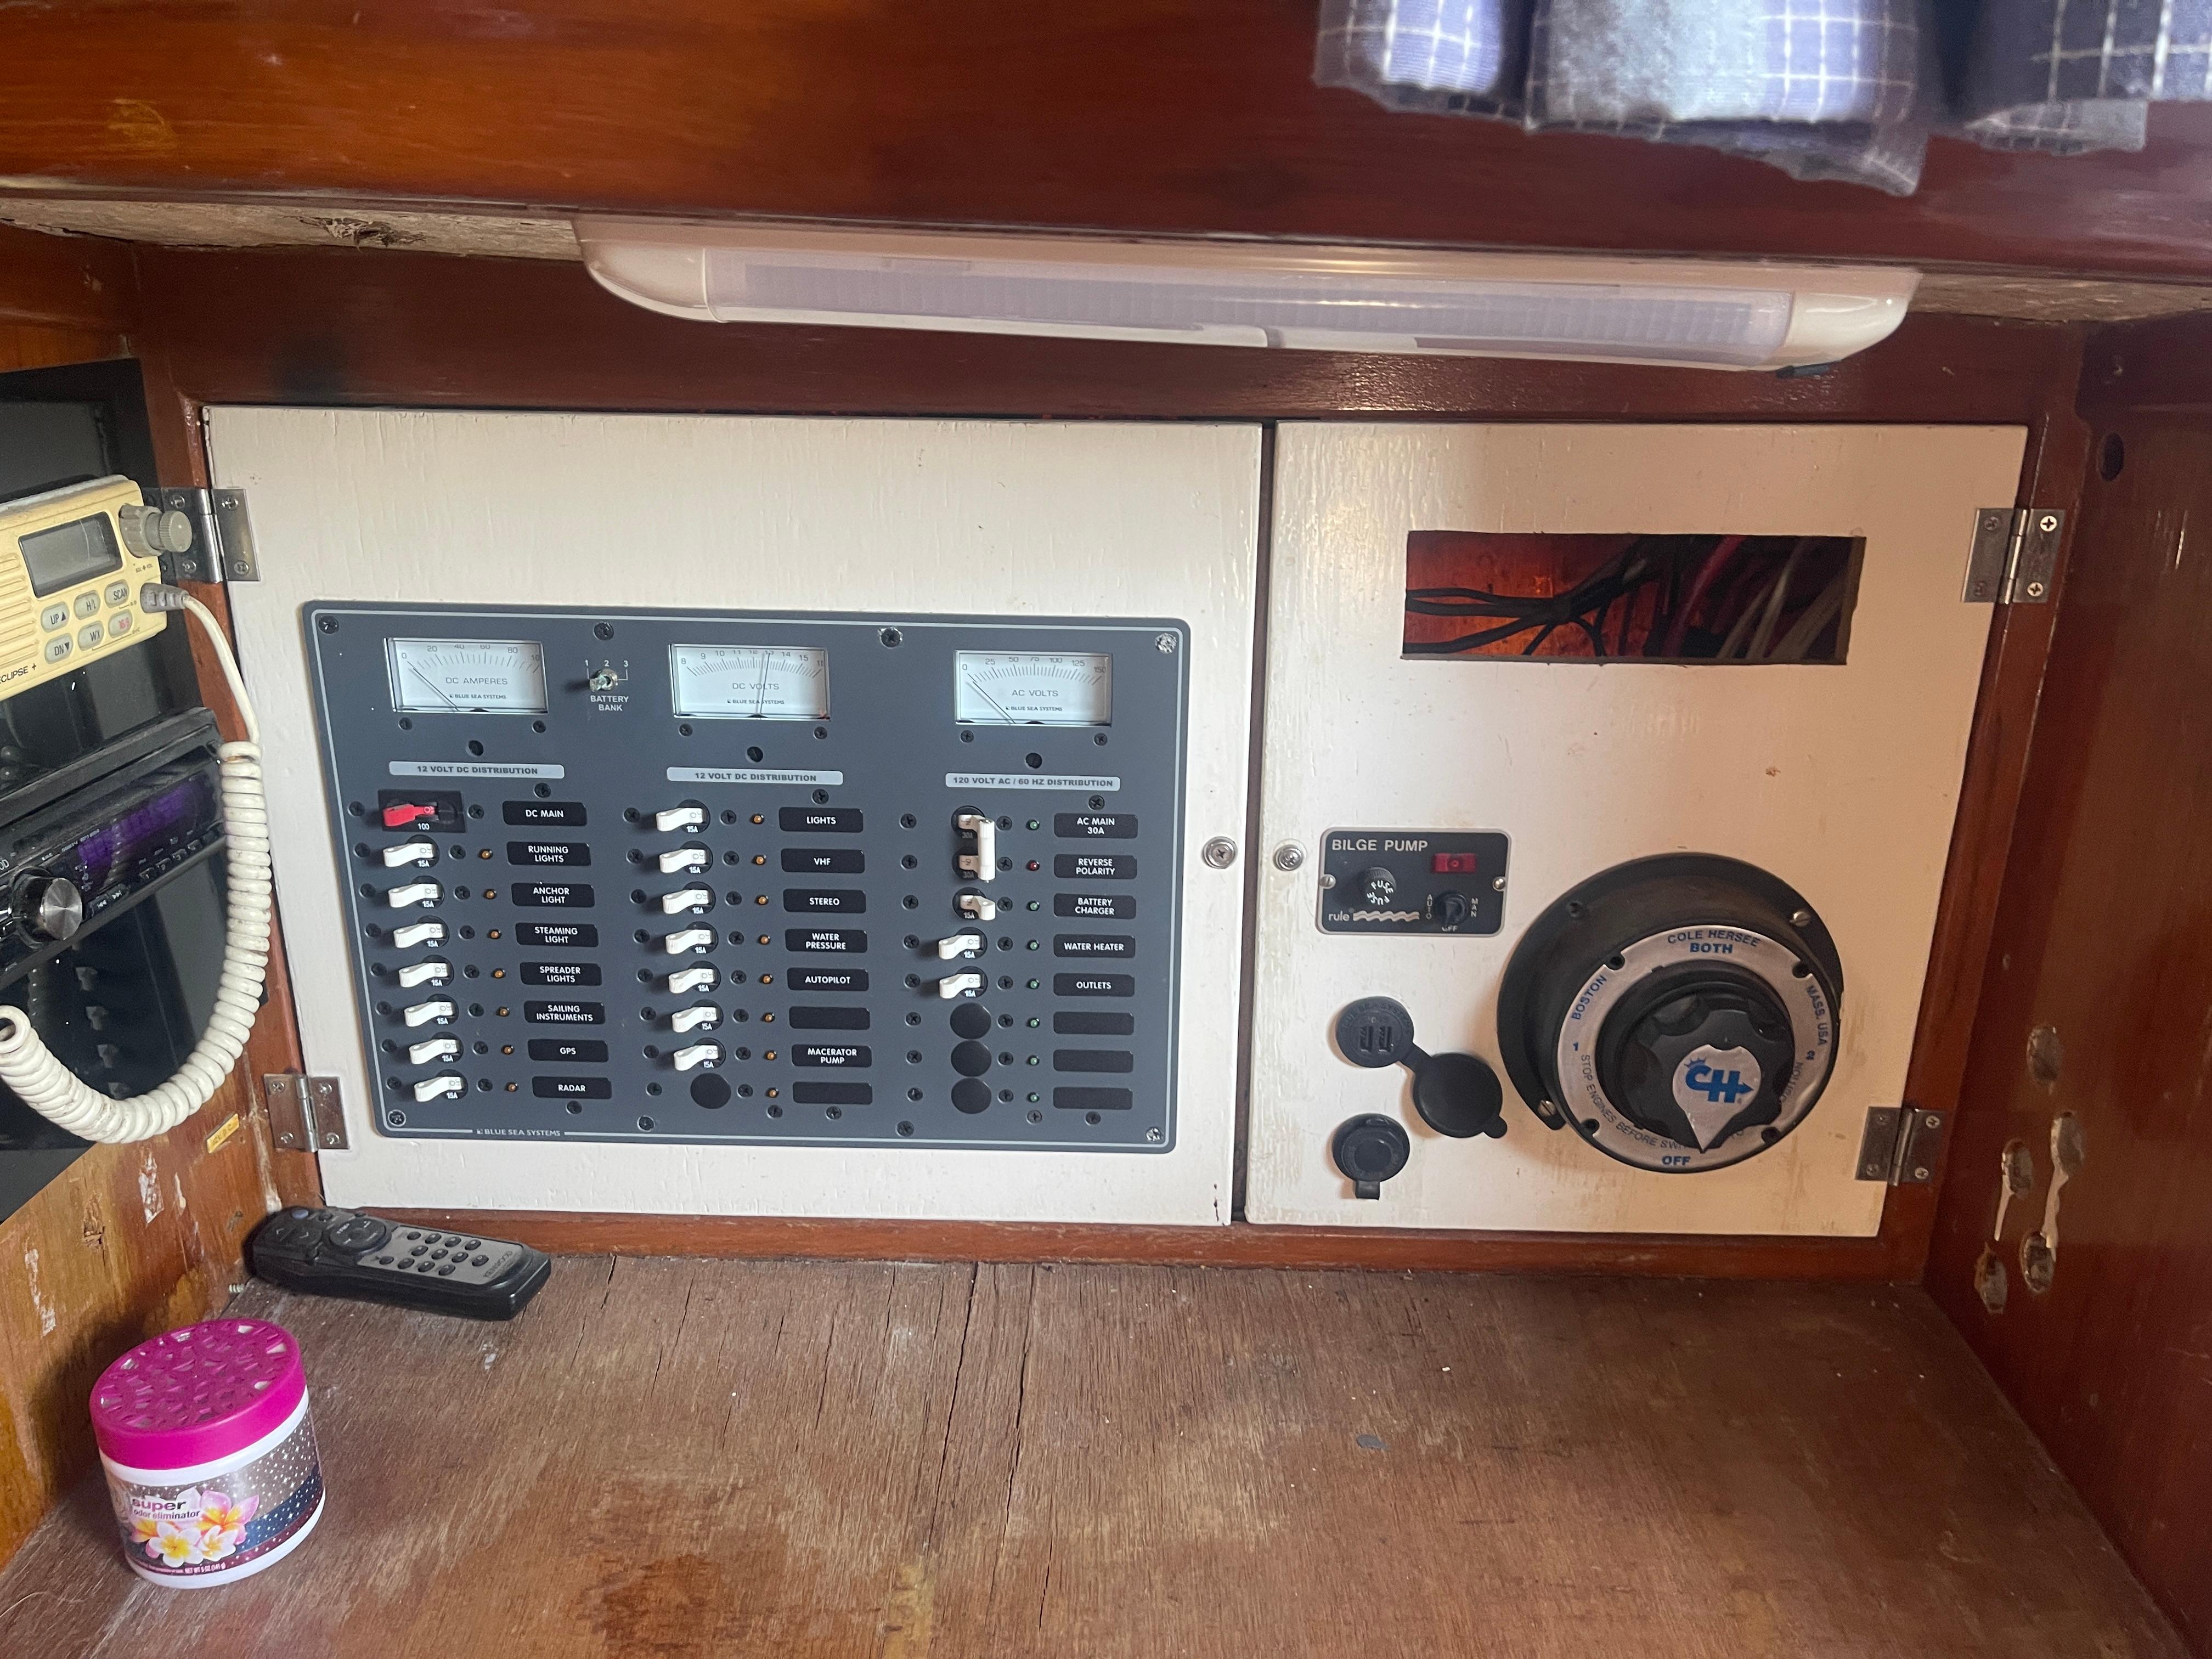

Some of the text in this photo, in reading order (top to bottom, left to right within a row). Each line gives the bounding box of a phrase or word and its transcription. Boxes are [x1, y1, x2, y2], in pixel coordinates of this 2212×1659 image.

[114, 588, 128, 601] SCAN
[50, 613, 60, 625] UP
[90, 629, 100, 642] WX
[54, 645, 64, 656] DN
[590, 695, 629, 703] BATTERY
[598, 703, 623, 712] BANK
[472, 766, 538, 775] DISTRIBUTION
[751, 774, 817, 782] DISTRIBUTION
[1047, 778, 1113, 787] DISTRIBUTION
[525, 809, 564, 818] DC MAIN
[806, 816, 837, 825] LIGHTS
[1076, 817, 1115, 826] AC MAIN
[417, 822, 430, 831] 100
[686, 825, 698, 833] 15A
[1087, 826, 1105, 835] 30A
[528, 845, 569, 854] RUNNING
[1331, 839, 1428, 851] BILGE PUMP
[534, 854, 564, 862] LIGHTS
[814, 857, 831, 866] VHF
[1077, 858, 1113, 867] REVERSE
[417, 860, 430, 868] 15A
[1076, 867, 1115, 876] POLARITY
[533, 887, 570, 895] ANCHOR
[1371, 880, 1393, 894] FUSE
[541, 895, 566, 904] LIGHT
[809, 898, 840, 906] STEREO
[1077, 898, 1113, 906] BATTERY
[1367, 891, 1390, 905] FUSE
[692, 906, 704, 915] 15A
[1075, 906, 1115, 915] CHARGER
[1328, 910, 1350, 922] rule
[534, 926, 578, 935] STEAMING
[544, 935, 569, 944] LIGHT
[811, 933, 840, 941] WATER
[1667, 930, 1761, 947] COLE HERSEE
[426, 940, 438, 948] 15A
[805, 941, 847, 950] PRESSURE
[1064, 943, 1124, 951] WATER HEATER
[1690, 943, 1733, 953] BOTH
[539, 966, 581, 974] SPREADER
[546, 974, 575, 983] LIGHTS
[805, 976, 851, 984] AUTOPILOT
[1571, 974, 1607, 1020] BOSTON
[547, 1005, 580, 1013] SAILING
[536, 1013, 594, 1022] INSTRUMENTS
[1818, 1023, 1829, 1046] USA
[560, 1047, 577, 1055] GPS
[1573, 1042, 1578, 1051] 1
[807, 1048, 857, 1056] MACERATOR
[820, 1057, 845, 1065] PUMP
[1581, 1054, 1593, 1080] STOP
[558, 1084, 586, 1092] RADAR
[1586, 1084, 1617, 1124] ENGINES
[1616, 1121, 1658, 1146] BEFORE
[1662, 1156, 1691, 1165] OFF
[132, 1499, 187, 1512] super
[134, 1509, 201, 1520] odor eliminator
